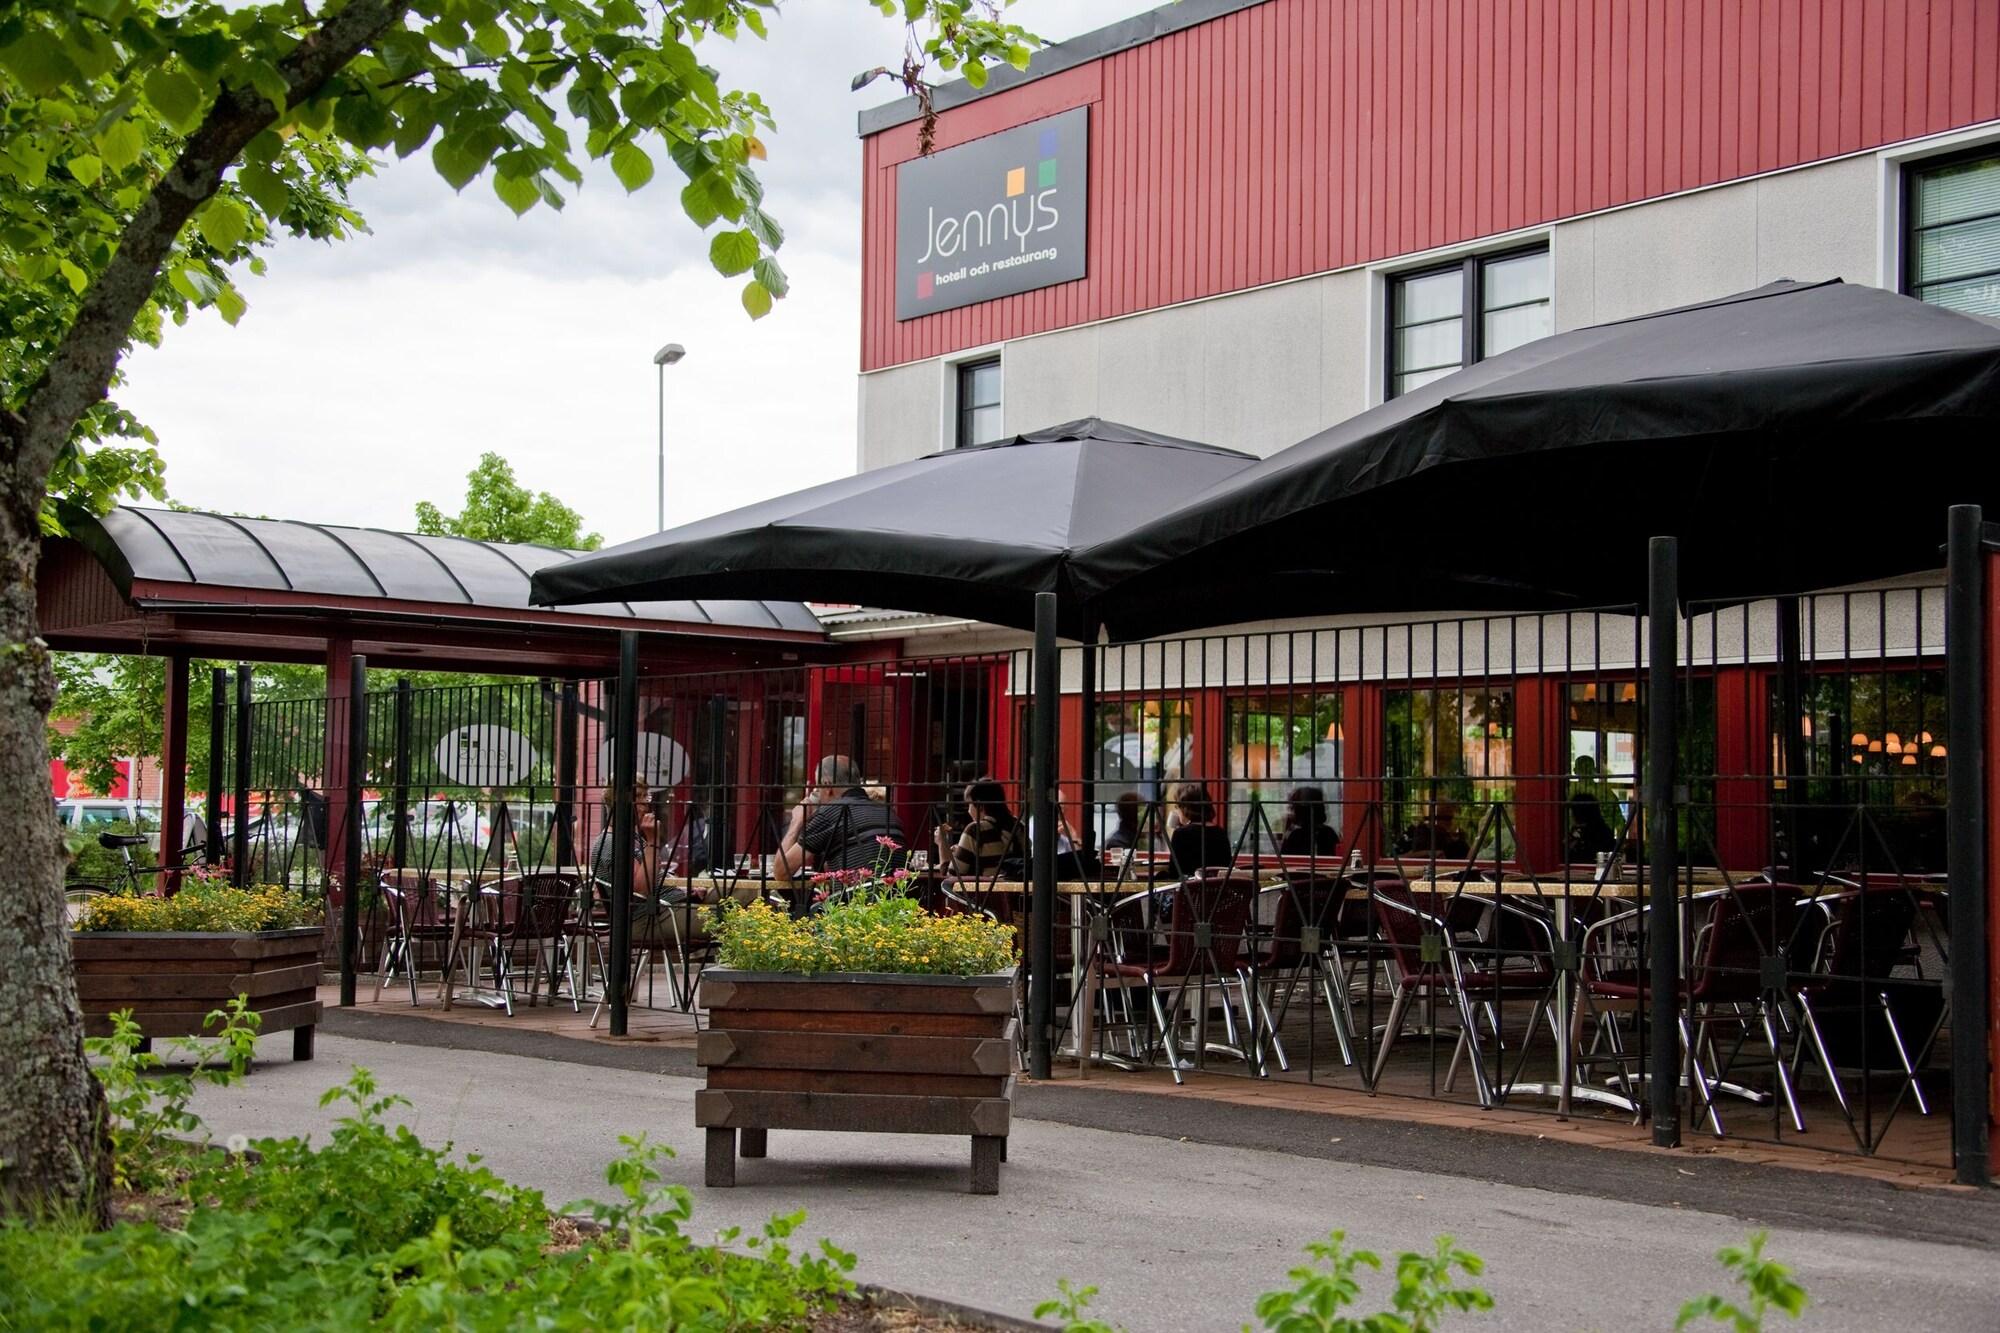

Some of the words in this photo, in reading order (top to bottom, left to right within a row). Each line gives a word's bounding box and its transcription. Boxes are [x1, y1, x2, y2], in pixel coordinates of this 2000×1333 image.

[917, 188, 1058, 264] Jennys
[935, 267, 967, 285] hotell
[969, 262, 990, 277] och
[993, 248, 1057, 271] restaurang
